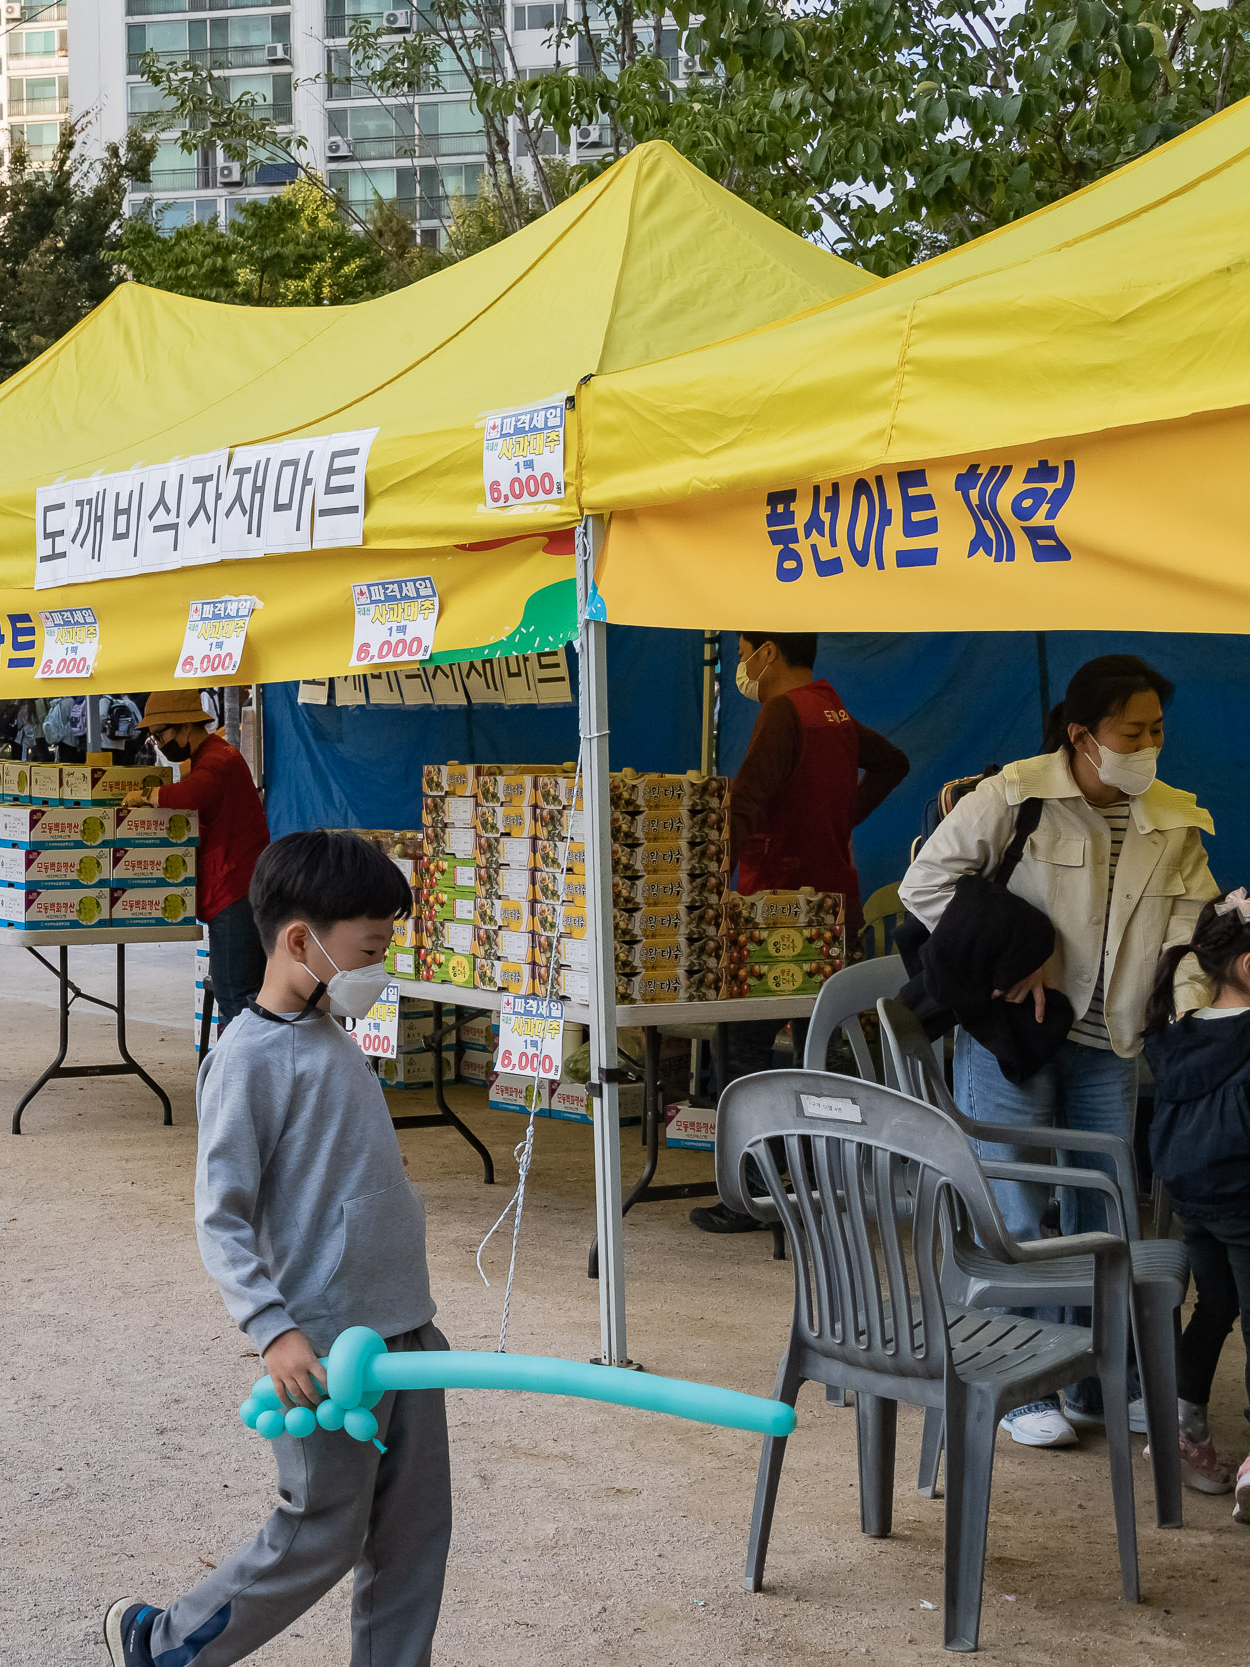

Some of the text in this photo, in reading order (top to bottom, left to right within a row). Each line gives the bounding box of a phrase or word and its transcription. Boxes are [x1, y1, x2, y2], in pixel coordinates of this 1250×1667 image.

[502, 408, 561, 434] 파격세일
[498, 430, 560, 460] 사과대추
[39, 447, 360, 563] 도깨비식자재마트
[765, 459, 1075, 583] 풍선아트 체험
[370, 580, 434, 601] 파격세일
[51, 610, 95, 624] 파격세일
[202, 601, 251, 618] 파격세일
[371, 599, 435, 625] 사과대추
[55, 625, 97, 645] 사과대추
[198, 619, 246, 640] 사과대추
[40, 819, 80, 834] 모동백화명산
[127, 819, 165, 832] 모동백화명산
[36, 861, 76, 874] 모동백화명산
[124, 859, 162, 872] 모동백화명산
[36, 901, 76, 914] 모동백화명산
[121, 899, 161, 912] 모동백화명산
[513, 999, 562, 1017] 파격세일
[511, 1016, 561, 1039] 사과대추
[675, 1120, 716, 1134] 모동백화명산
